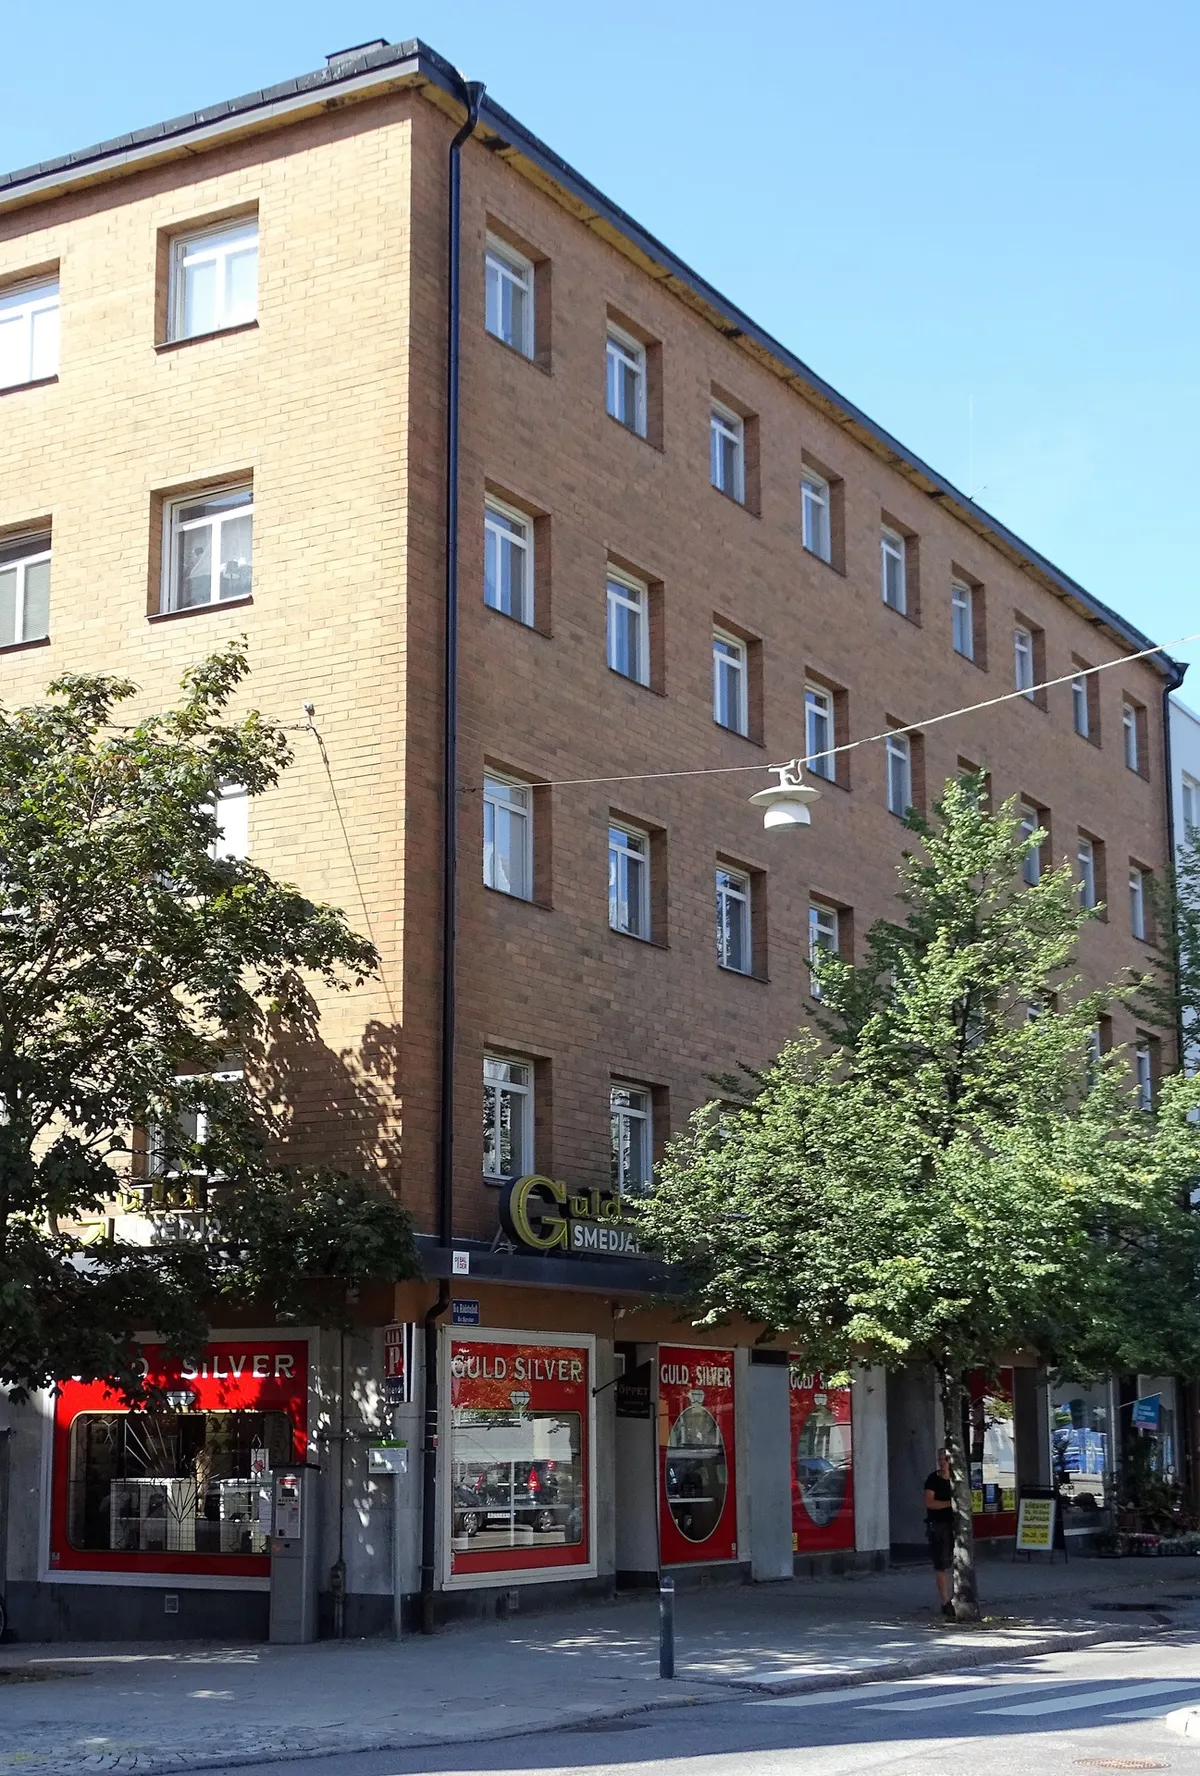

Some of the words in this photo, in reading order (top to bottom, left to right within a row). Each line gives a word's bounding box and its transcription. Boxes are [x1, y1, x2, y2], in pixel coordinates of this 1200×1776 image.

[503, 1174, 622, 1250] Guld
[180, 1354, 296, 1380] SILVER
[451, 1354, 507, 1379] GULD
[514, 1357, 583, 1382] SILVER
[660, 1364, 690, 1385] GULD
[695, 1366, 732, 1388] SILVER
